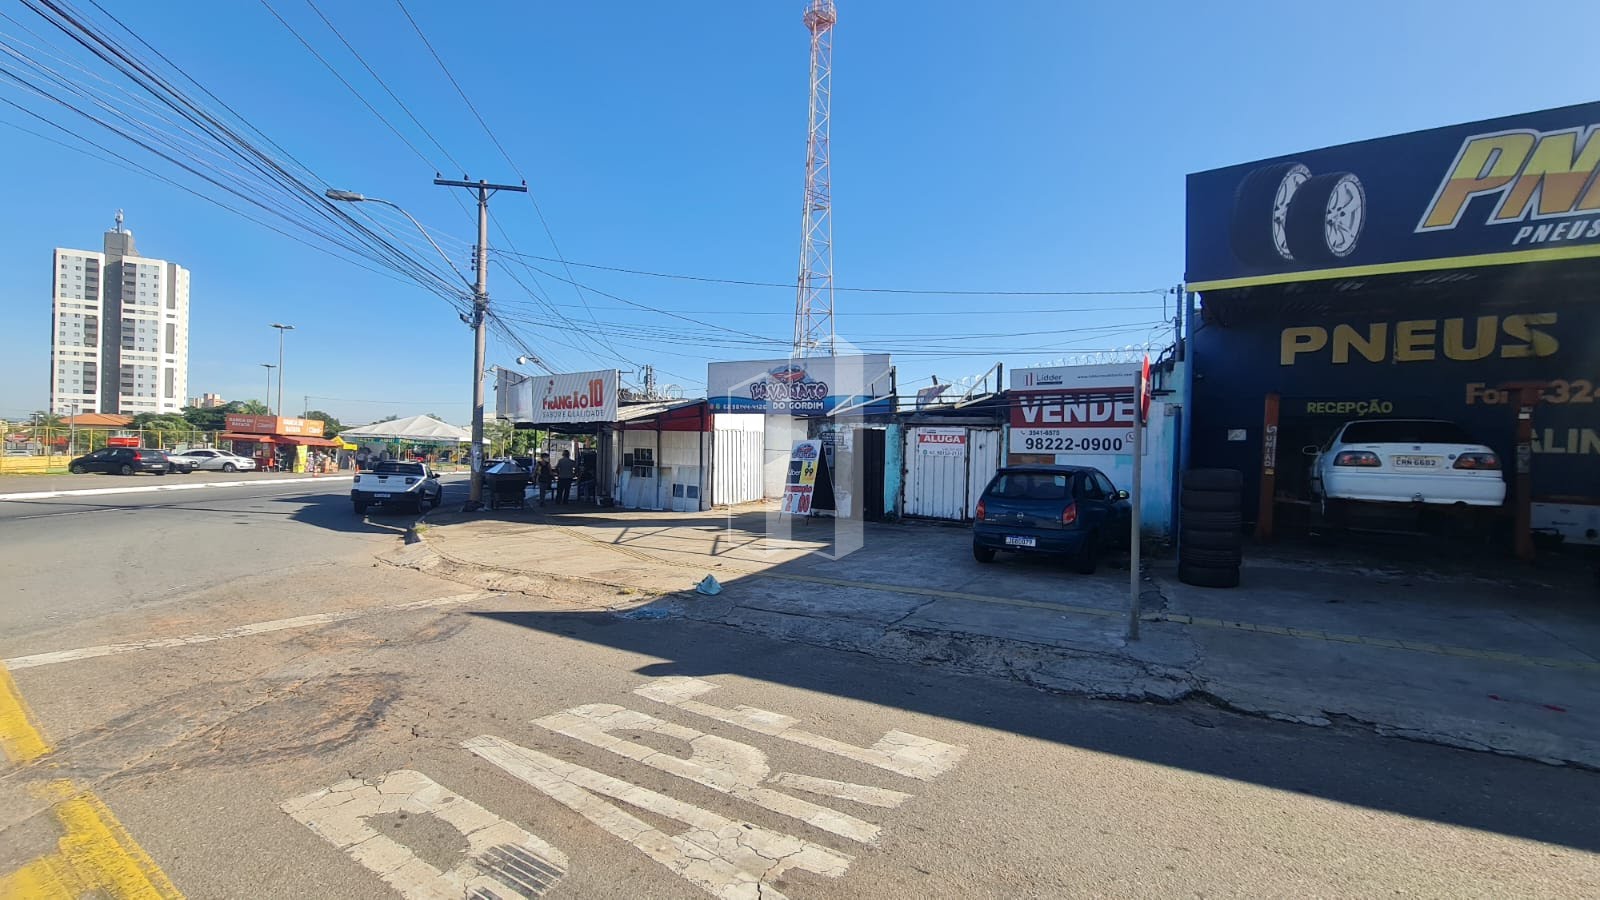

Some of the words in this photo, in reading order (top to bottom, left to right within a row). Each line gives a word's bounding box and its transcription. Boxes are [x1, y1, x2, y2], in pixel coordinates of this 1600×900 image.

[1280, 312, 1560, 366] PNEUS
[589, 378, 604, 408] 10
[750, 381, 787, 401] LAVA
[789, 381, 829, 401] JATO
[772, 402, 785, 410] DO
[789, 402, 823, 410] GORDIM
[1020, 393, 1135, 424] VENDE
[1307, 399, 1393, 417] RECEPÇÃO
[924, 435, 961, 443] ALUGA
[1025, 438, 1122, 451] 98222-0900
[278, 676, 969, 900] PARE
